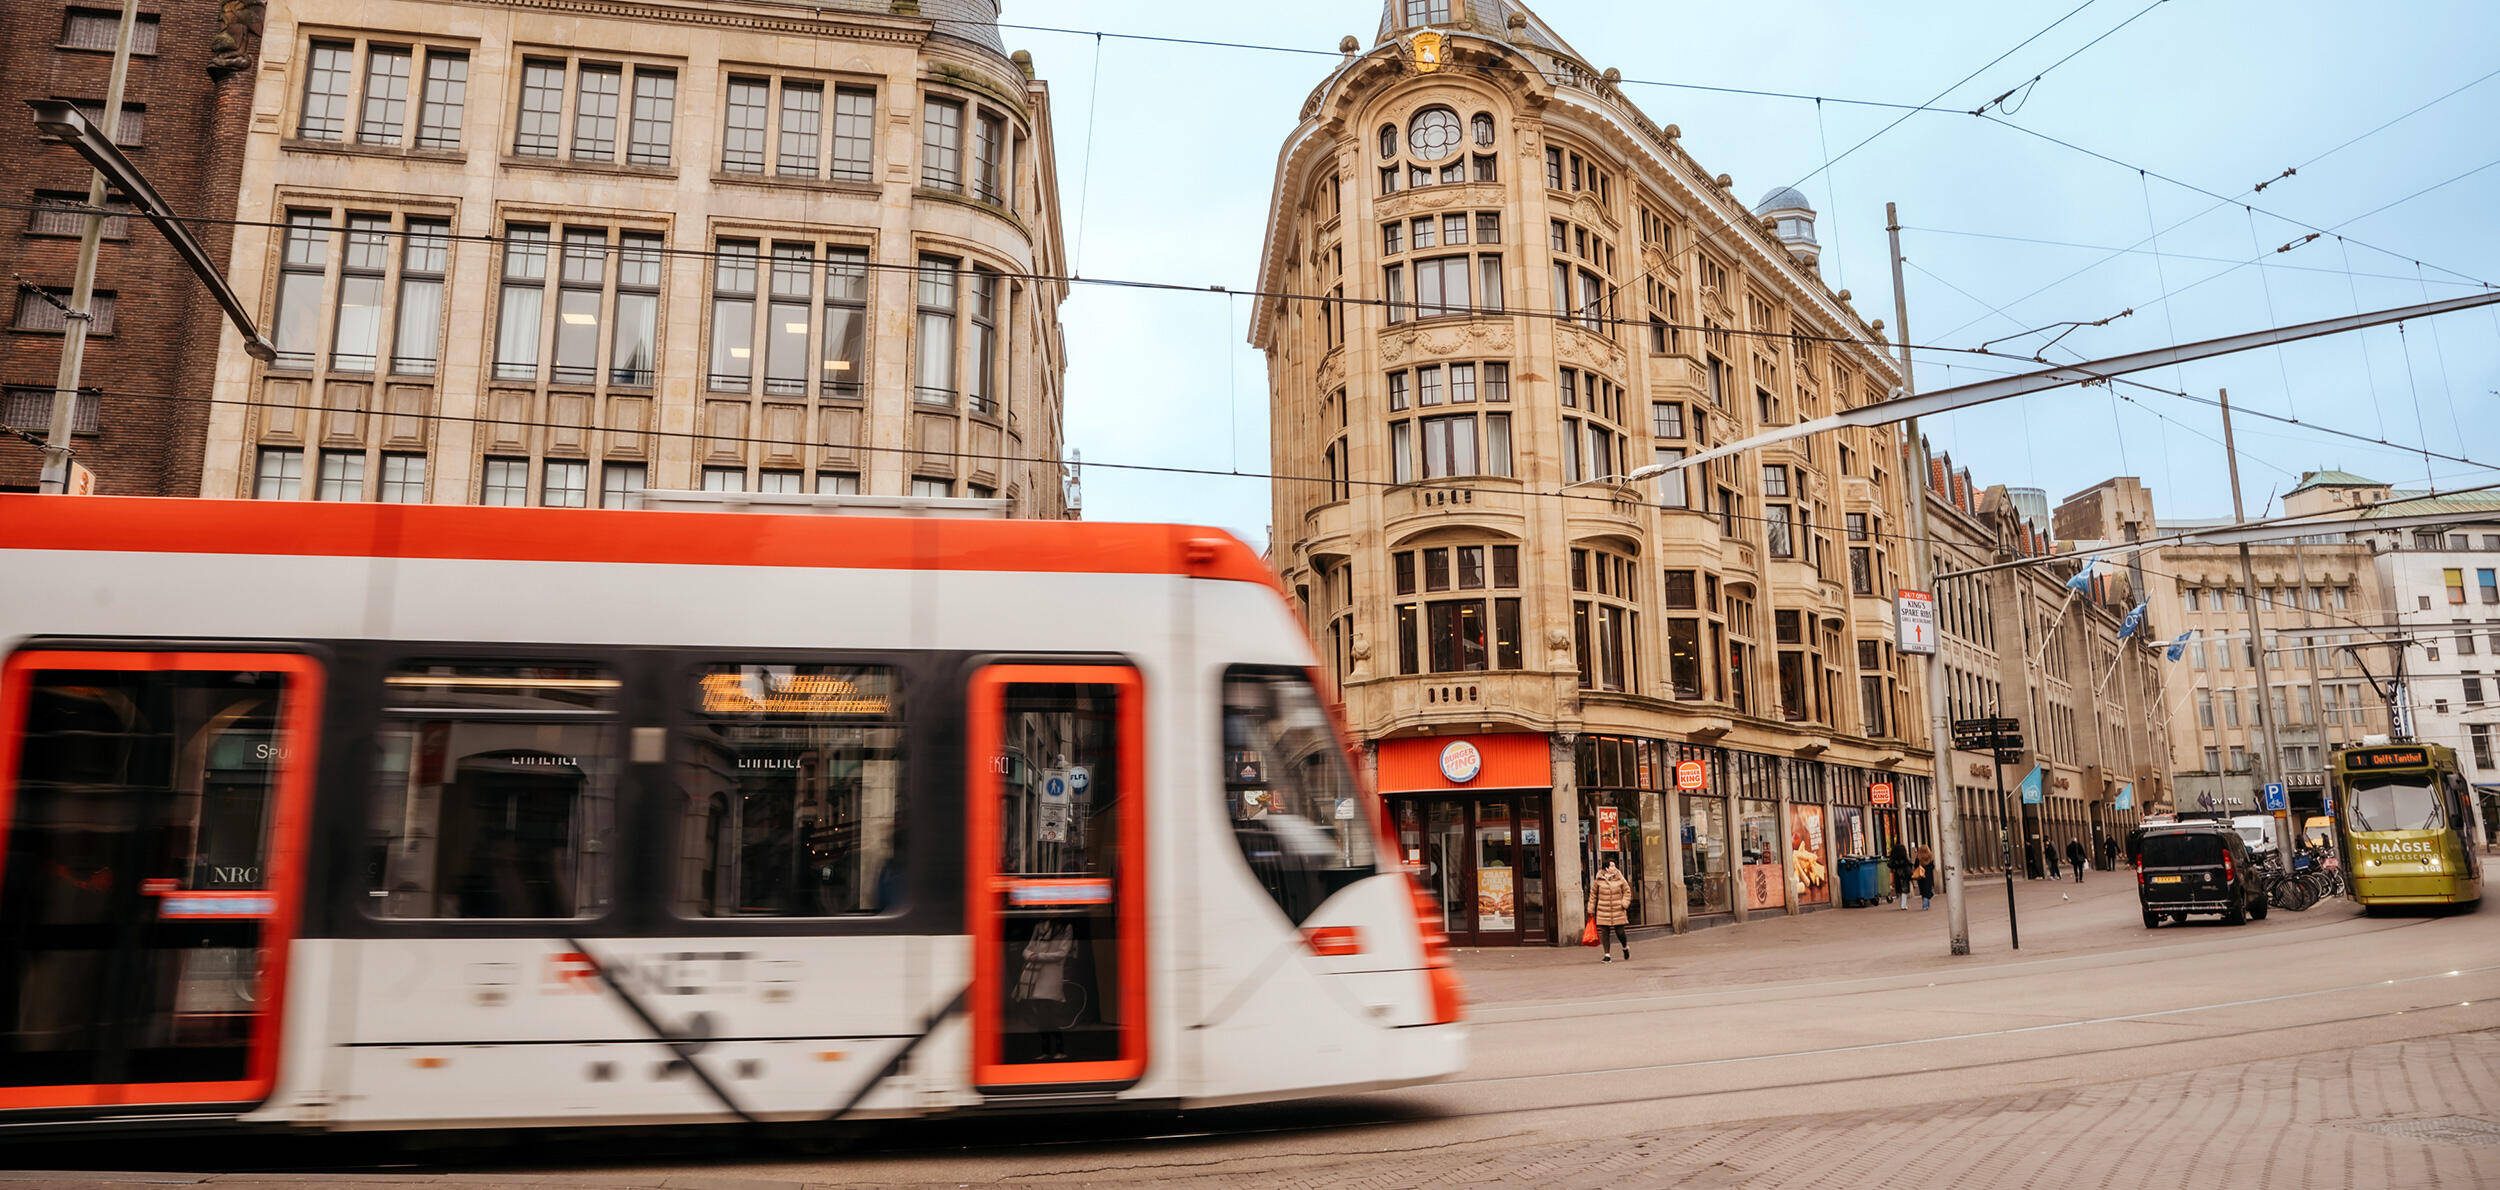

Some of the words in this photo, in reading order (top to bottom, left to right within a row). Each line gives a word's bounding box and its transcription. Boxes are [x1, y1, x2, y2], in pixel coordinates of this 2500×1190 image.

[1901, 608, 1919, 617] SPARE
[1920, 610, 1932, 619] RIBS
[1444, 747, 1474, 765] BURGER
[2355, 755, 2362, 765] 1
[2372, 754, 2393, 764] Delft
[1680, 775, 1700, 783] KING
[2268, 785, 2279, 799] P
[2370, 841, 2432, 853] HAAGSE
[213, 866, 259, 883] NRC
